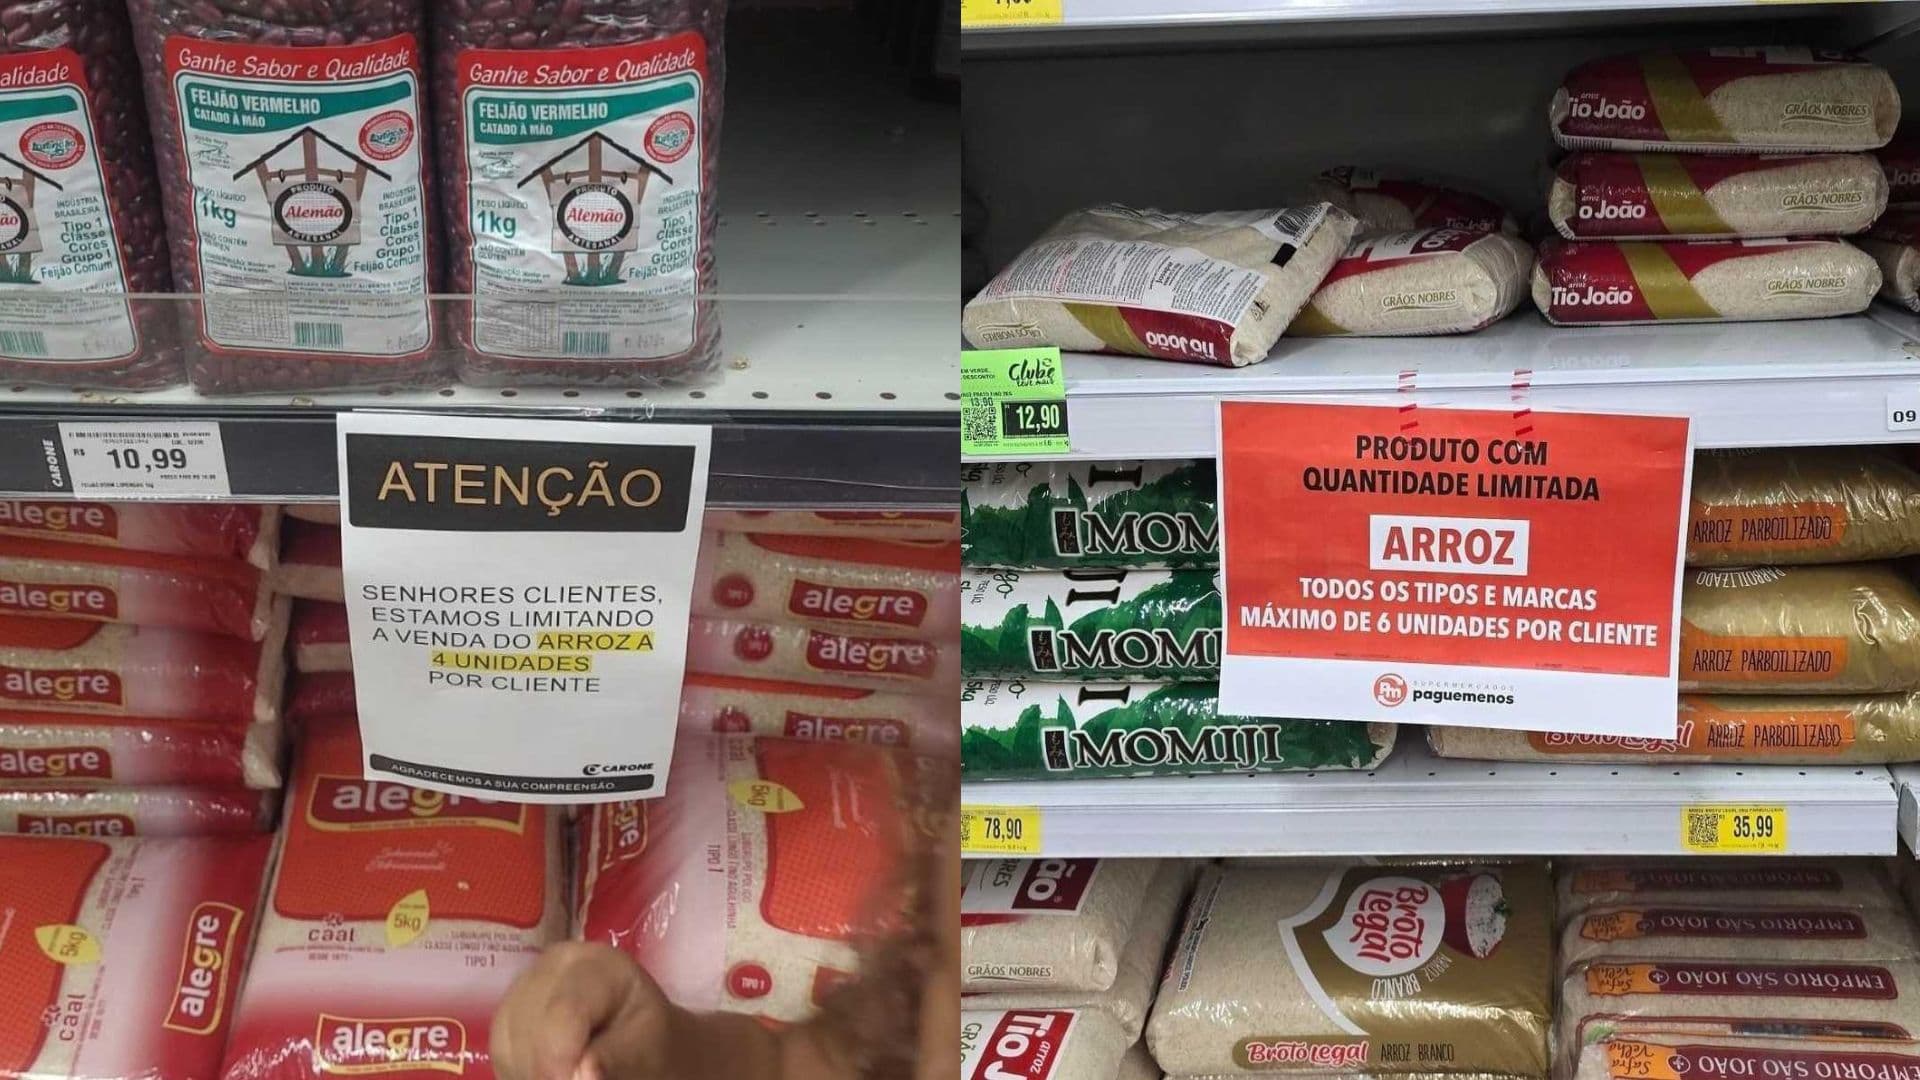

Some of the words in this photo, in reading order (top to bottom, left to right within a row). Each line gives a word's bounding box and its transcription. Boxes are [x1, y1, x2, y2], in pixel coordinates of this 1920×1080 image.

[178, 48, 236, 74] Ganhe
[242, 55, 300, 78] Sabor
[307, 64, 318, 79] e
[325, 48, 410, 81] Qualidade
[470, 63, 528, 84] Ganhe
[534, 64, 592, 84] Sabor
[597, 67, 608, 80] e
[615, 48, 696, 80] Qualidade
[190, 87, 239, 109] FEIJÃO
[242, 95, 321, 115] VERMELHO
[479, 101, 528, 119] FEIJÃO
[532, 102, 608, 119] VERMELHO
[1594, 98, 1646, 121] João
[1784, 102, 1822, 116] GRÃOS
[1824, 104, 1868, 116] NOBRES
[194, 109, 231, 124] CATADO
[242, 114, 266, 128] MÃO
[480, 122, 518, 135] CATADO
[529, 123, 554, 135] MÃO
[289, 183, 336, 197] PRODUTO
[1783, 193, 1820, 207] GRÃOS
[1820, 190, 1863, 205] NOBRES
[285, 205, 344, 220] Alemão
[383, 212, 411, 226] Tipo
[567, 207, 624, 224] Alemão
[1594, 199, 1646, 220] João
[62, 221, 92, 233] Tipo
[379, 219, 420, 237] Classe
[477, 210, 517, 238] 1kg
[656, 225, 694, 241] Classe
[661, 216, 687, 230] Tipo
[61, 230, 106, 243] Classe
[69, 239, 109, 254] Cores
[385, 232, 420, 248] Cores
[661, 238, 693, 253] Cores
[61, 252, 104, 265] Grupo
[376, 245, 415, 261] Grupo
[652, 249, 689, 265] Grupo
[41, 265, 72, 281] Feijão
[74, 260, 113, 275] Comum
[353, 260, 385, 274] Feijão
[386, 254, 421, 270] Comum
[629, 266, 659, 281] Feijão
[1551, 286, 1580, 305] Tio
[1582, 284, 1633, 306] João
[1767, 279, 1804, 292] GRÃOS
[1805, 277, 1846, 291] NOBRES
[1382, 292, 1417, 308] GRÃOS
[1417, 290, 1456, 305] NOBRES
[1145, 330, 1188, 352] João
[1189, 340, 1217, 361] Tio
[1008, 358, 1056, 381] Clube
[1015, 404, 1060, 433] 12,90
[1892, 410, 1917, 423] 09
[74, 448, 86, 457] R$
[106, 448, 187, 472] 10,99
[1356, 434, 1480, 464] PRODUTO
[1487, 440, 1548, 466] COM
[42, 440, 63, 487] CARONE
[377, 460, 663, 517] ATENÇÃO
[1303, 466, 1469, 497] QUANTIDADE
[1477, 472, 1601, 501] LIMITADA
[0, 502, 104, 529] alegre
[1693, 519, 1732, 543] ARROZ
[1741, 516, 1832, 543] PARBOILIZADO
[1382, 526, 1515, 565] ARROZ
[1696, 566, 1787, 588] PARBOILIZADO
[1, 584, 104, 612] alegre
[362, 584, 515, 605] SENHORES
[524, 584, 663, 605] CLIENTES,
[803, 588, 915, 619] alegre
[1300, 576, 1375, 601] TODOS
[1380, 580, 1409, 602] OS
[1415, 581, 1479, 606] TIPOS
[1484, 585, 1496, 606] E
[1503, 587, 1597, 611] MARCAS
[372, 606, 501, 628] ESTAMOS
[509, 608, 655, 628] LIMITANDO
[1240, 601, 1338, 632] MÁXIMO
[1343, 610, 1372, 633] DE
[1377, 611, 1391, 633] 6
[1397, 613, 1509, 639] UNIDADES
[1516, 619, 1562, 641] POR
[1568, 621, 1658, 647] CLIENTE
[372, 627, 389, 642] A
[398, 630, 487, 649] VENDA
[494, 633, 532, 650] DO
[537, 633, 631, 651] ARROZ
[636, 634, 654, 651] A
[432, 651, 446, 667] 4
[455, 653, 590, 672] UNIDADES
[819, 638, 926, 670] alegre
[1693, 649, 1732, 672] ARROZ
[1741, 649, 1832, 672] PARBOILIZADO
[6, 671, 110, 700] alegre
[429, 671, 483, 689] POR
[491, 676, 600, 693] CLIENTE
[1412, 678, 1517, 691] SUPERMERCADOS
[1412, 687, 1515, 705] paguemenos
[1707, 722, 1746, 749] ARROZ
[1753, 722, 1843, 749] PARBOILIZADO
[1073, 727, 1284, 769] MOMIJI
[0, 750, 99, 776] alegre
[602, 762, 655, 773] CARONE
[391, 763, 484, 787] AGRADECEMOS
[484, 778, 492, 788] A
[495, 779, 520, 792] SUA
[521, 780, 615, 792] COMPREENSÃO
[748, 784, 771, 807] 5kg
[984, 817, 1023, 842] 78,90
[1733, 815, 1774, 841] 35,99
[393, 913, 421, 932] 5kg
[1349, 889, 1394, 963] Legal
[1389, 886, 1430, 960] Broto
[1660, 914, 1708, 932] JOÃO
[1716, 917, 1756, 932] SÃO
[1760, 918, 1855, 934] EMPÓRIO
[60, 931, 87, 957] 5kg
[307, 925, 355, 943] caal
[181, 914, 222, 1017] alegre
[464, 955, 488, 968] TIPO
[967, 963, 1006, 976] GRÃOS
[1008, 966, 1052, 976] NOBRES
[1371, 975, 1422, 1002] BRANCO
[1676, 971, 1729, 989] JOÃO
[1735, 971, 1780, 989] SÃO
[1783, 973, 1885, 993] EMPÓRIO
[59, 994, 86, 1041] caal
[332, 1022, 449, 1060] alegre
[996, 1013, 1055, 1058] Tio
[1029, 1041, 1051, 1075] arroz
[1380, 1044, 1411, 1062] ARROZ
[1418, 1043, 1454, 1062] BRANCO
[1610, 1058, 1652, 1077] Safra
[1698, 1055, 1757, 1077] JOÃO
